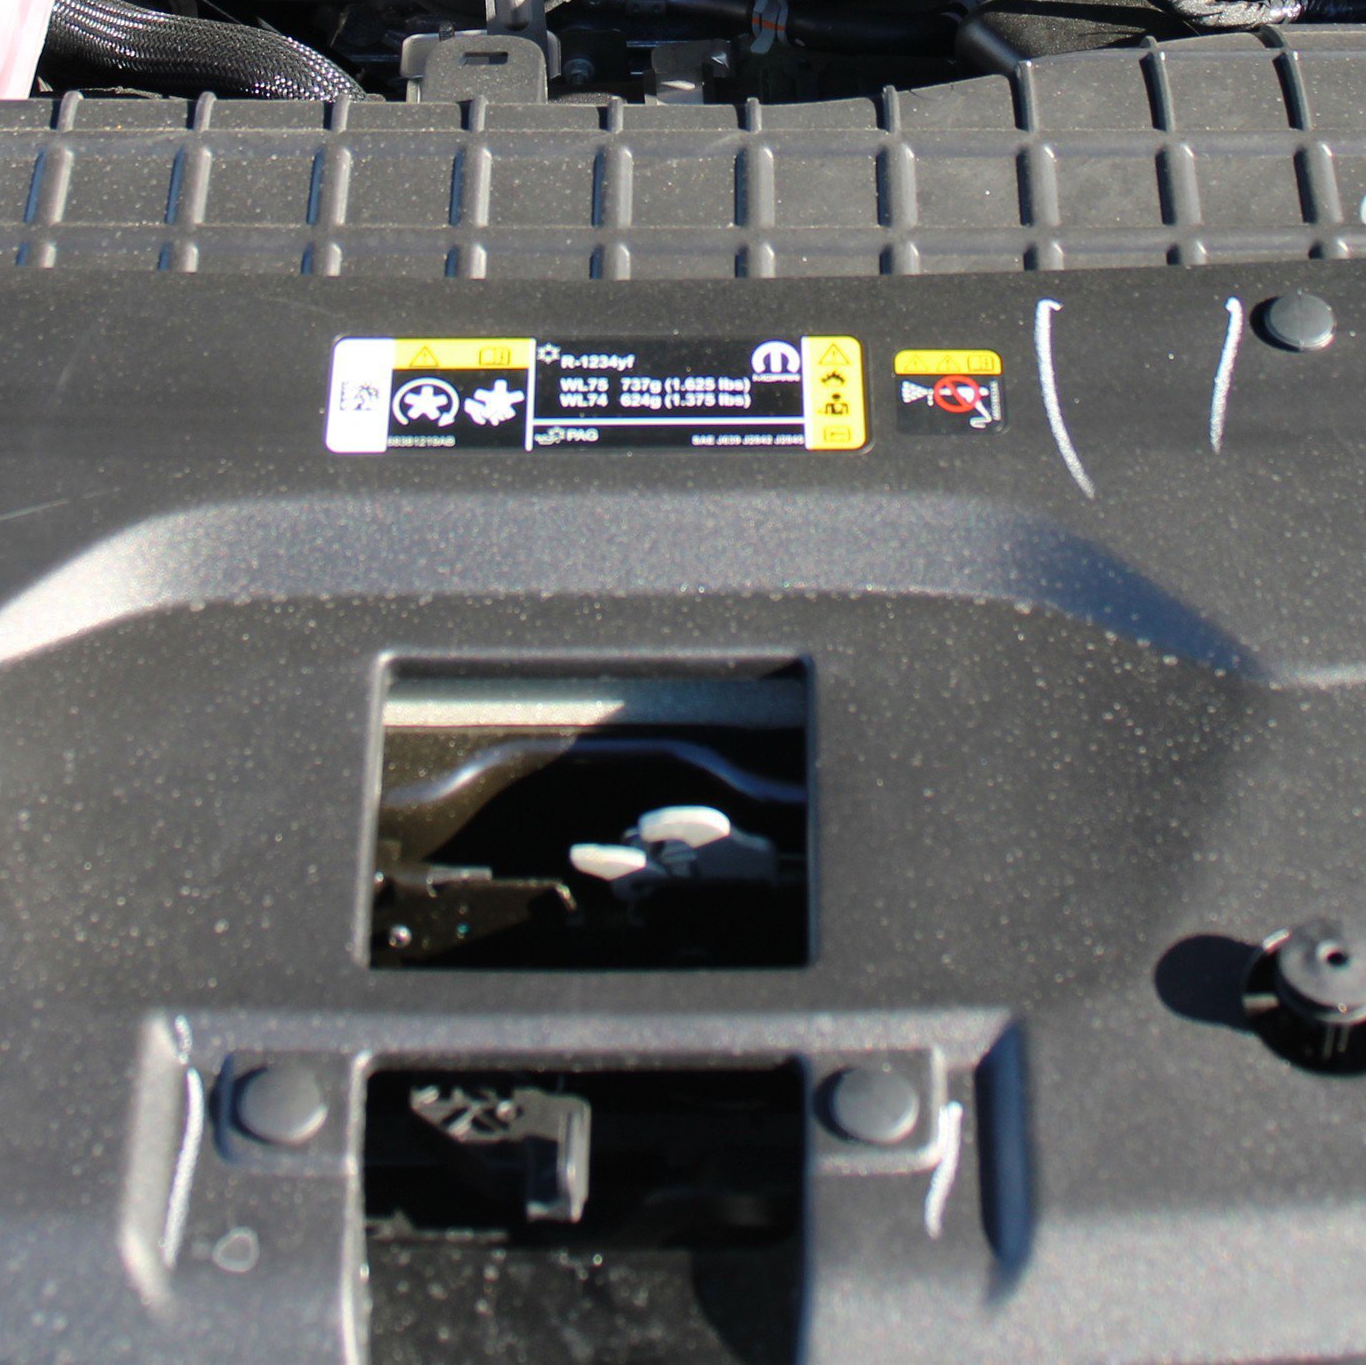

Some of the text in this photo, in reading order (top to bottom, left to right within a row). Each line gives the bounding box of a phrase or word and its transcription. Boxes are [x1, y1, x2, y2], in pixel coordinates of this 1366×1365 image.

[560, 354, 635, 371] R-1234yf
[751, 373, 801, 383] MOPAR
[559, 377, 751, 395] WL75 737g (1.625 lbs)
[559, 393, 751, 410] WL74 624g (1.375 lbs)
[566, 428, 599, 442] PAG
[691, 434, 715, 446] SAE
